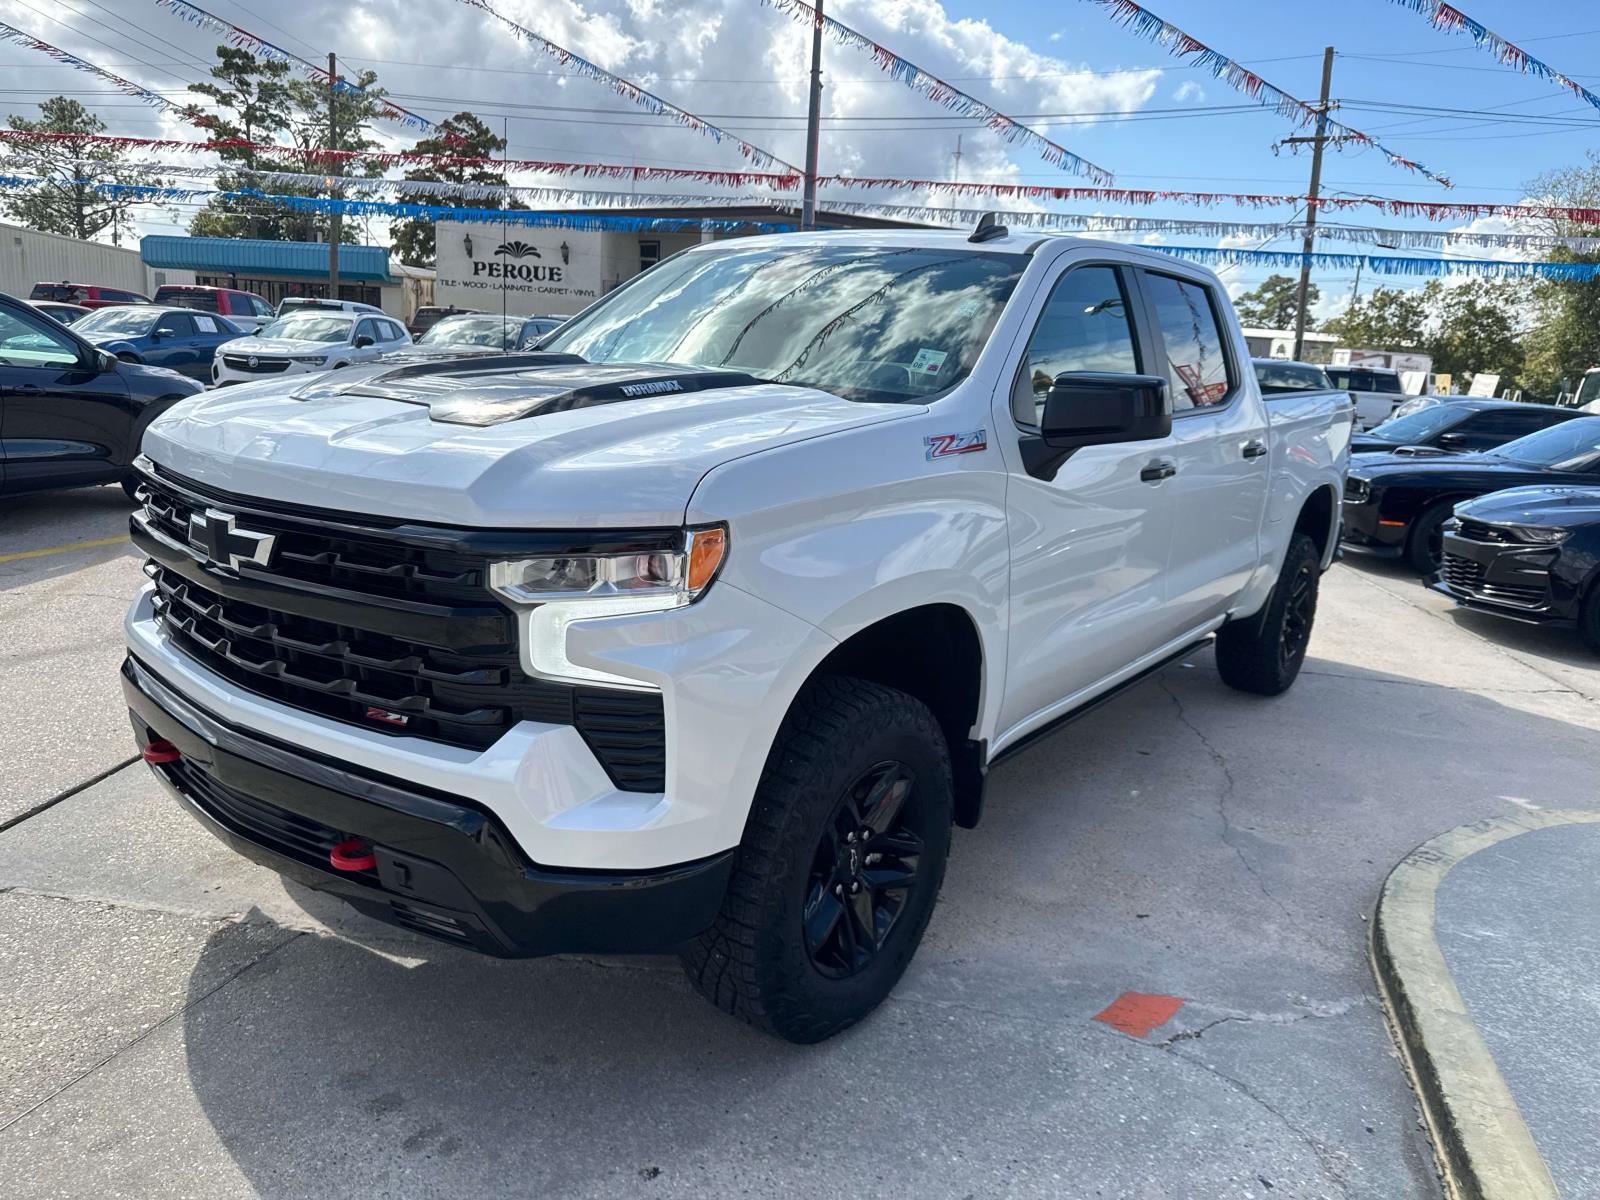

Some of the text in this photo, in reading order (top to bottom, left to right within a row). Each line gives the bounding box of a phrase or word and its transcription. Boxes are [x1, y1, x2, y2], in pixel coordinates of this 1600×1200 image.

[473, 261, 563, 283] PERQUE
[440, 279, 597, 297] TILE WOOD LAMINATE CARPET VINYL
[619, 379, 684, 398] DURAMAX
[924, 429, 988, 461] Z71
